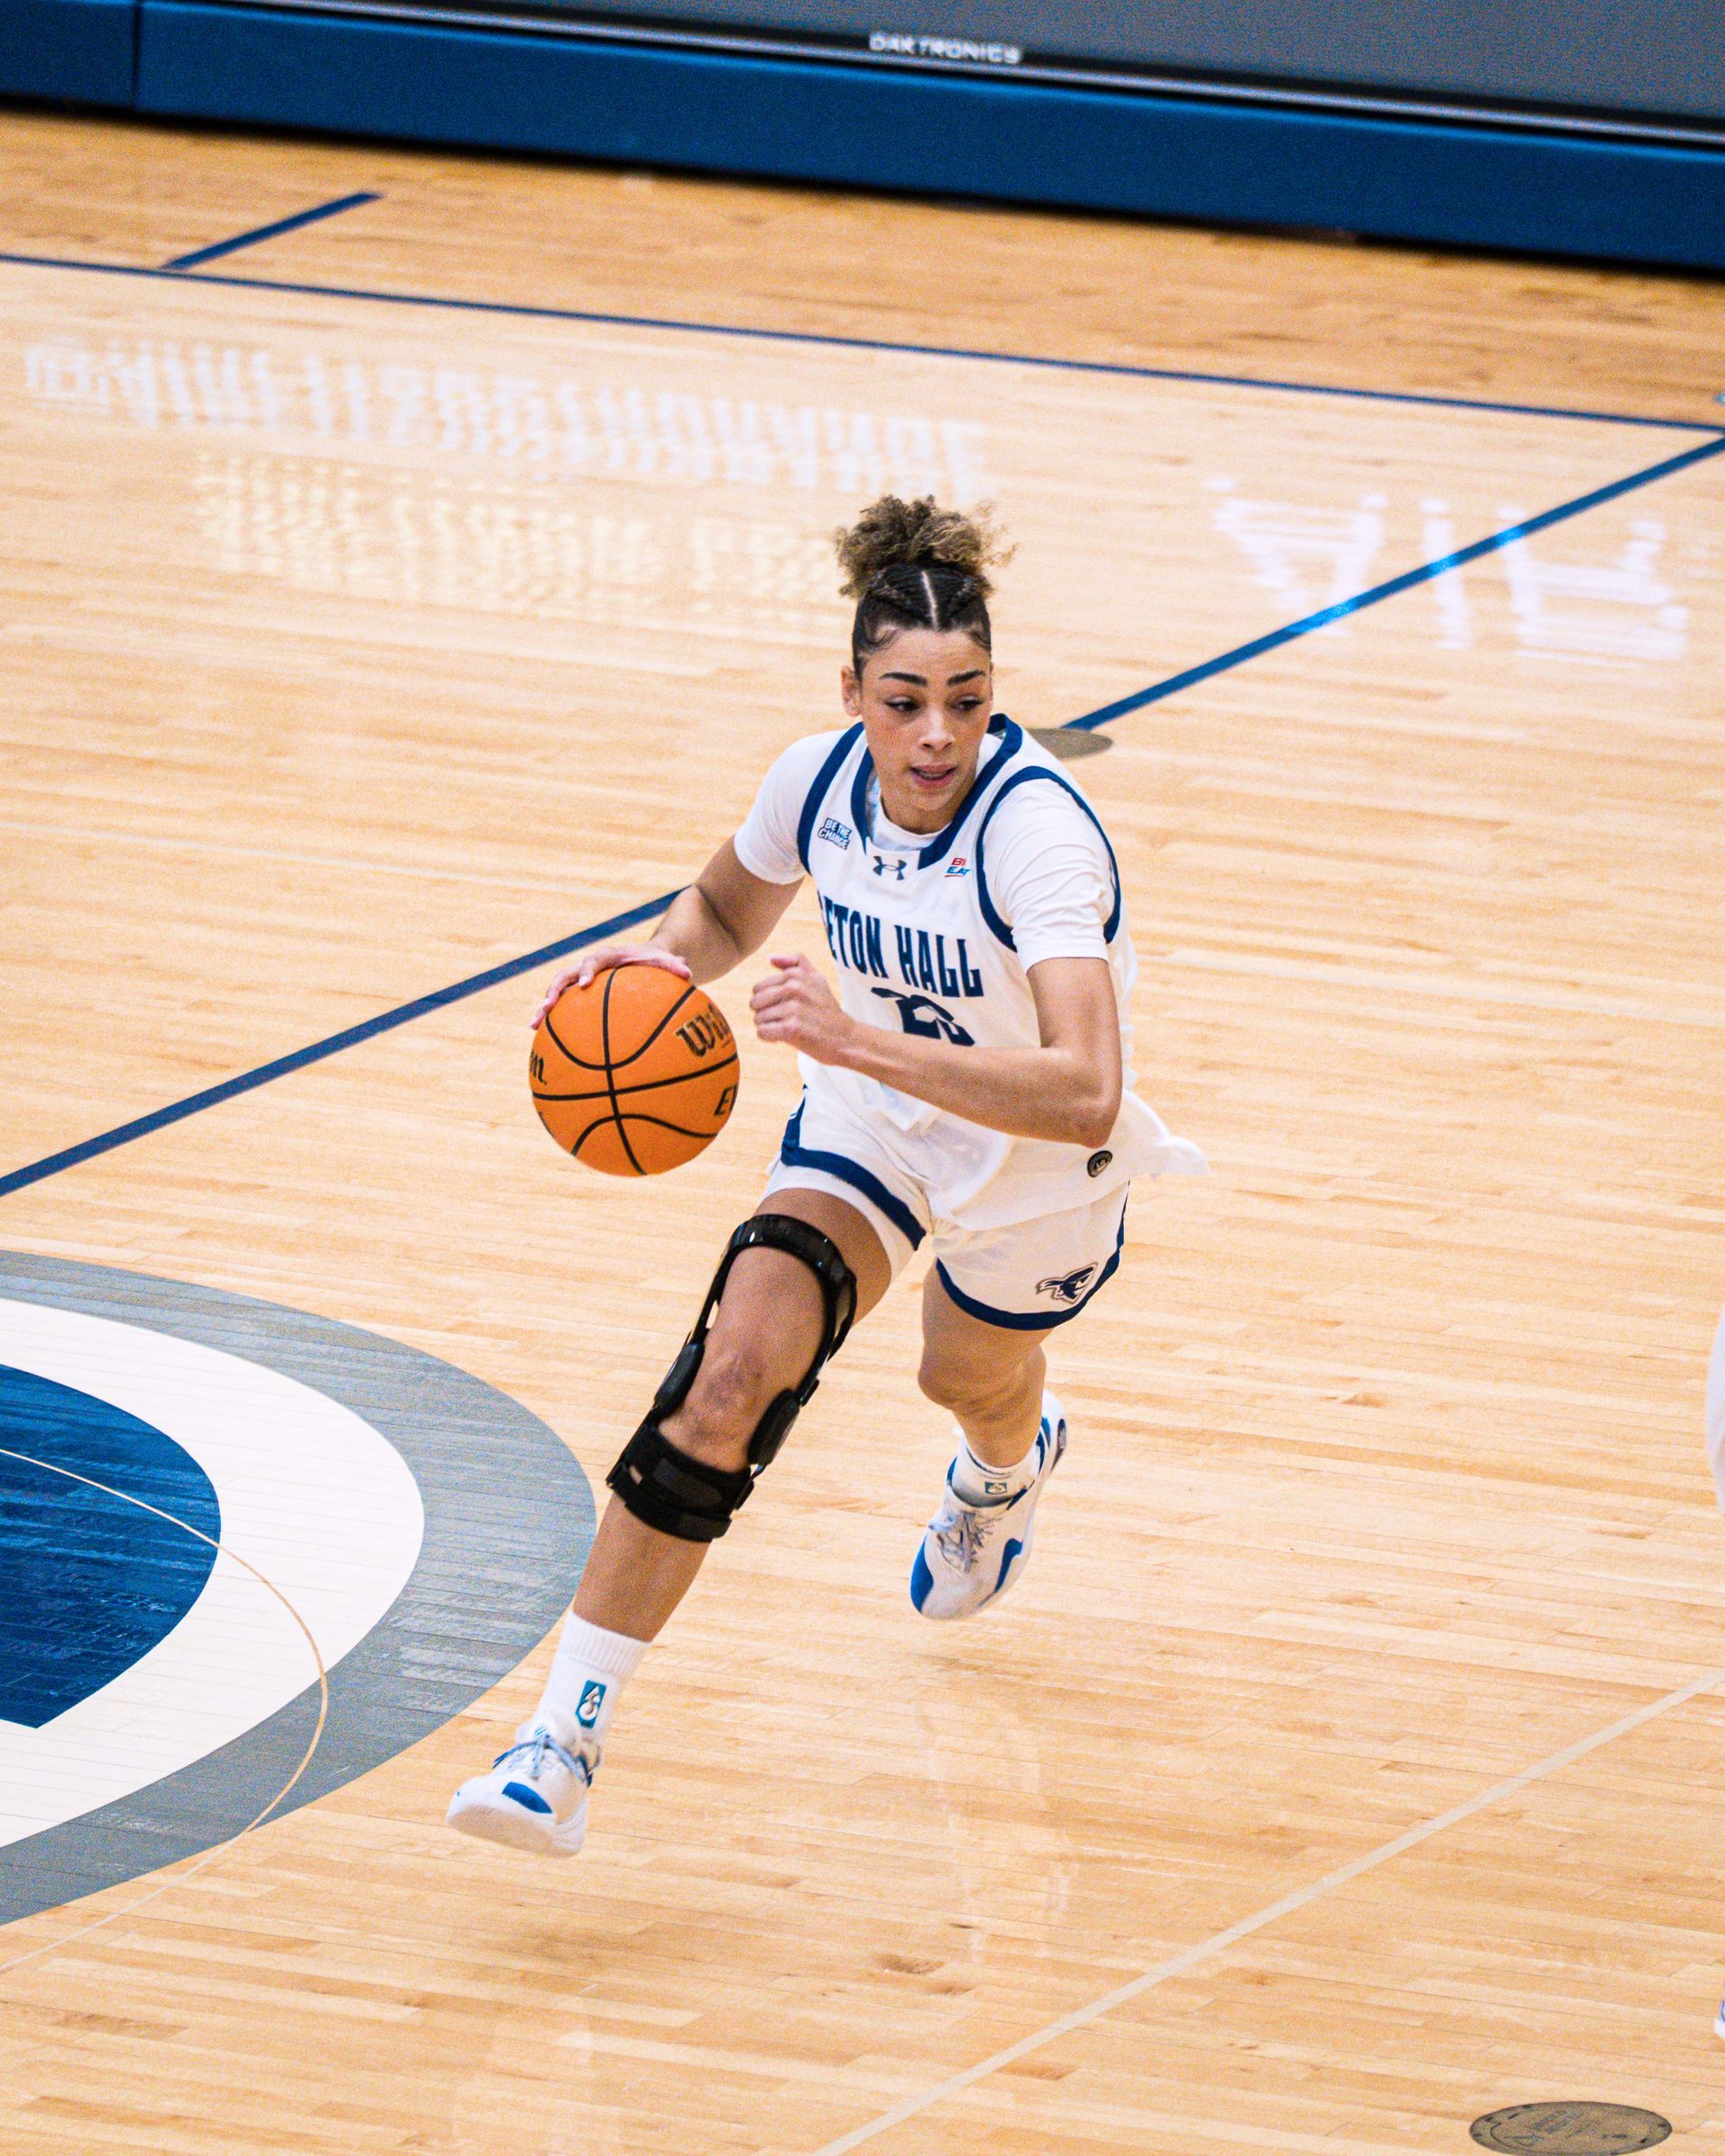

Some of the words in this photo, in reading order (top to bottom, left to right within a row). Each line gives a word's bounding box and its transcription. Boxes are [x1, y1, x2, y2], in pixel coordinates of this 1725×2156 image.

[818, 827, 850, 850] CHANGE
[951, 858, 967, 867] BI
[821, 895, 889, 979] ETON
[894, 924, 984, 998] HALL
